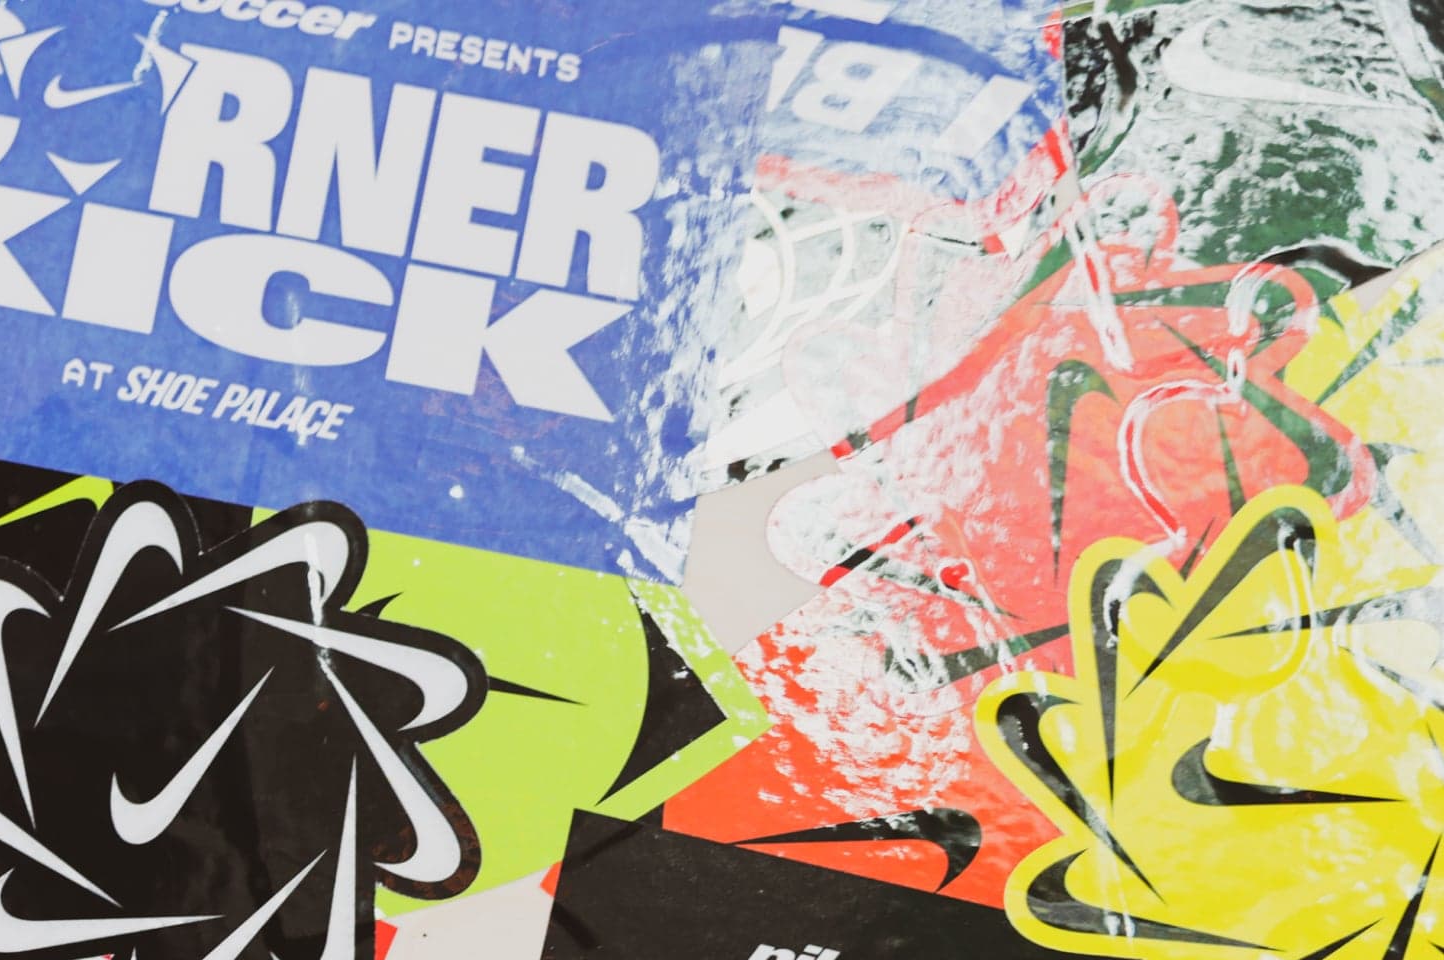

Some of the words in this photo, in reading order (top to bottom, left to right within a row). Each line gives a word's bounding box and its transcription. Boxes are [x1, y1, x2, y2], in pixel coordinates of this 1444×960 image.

[142, 0, 376, 40] ccer
[388, 21, 582, 82] PRESENTS
[61, 358, 113, 391] AT
[116, 365, 220, 416] SHOE
[211, 383, 355, 442] PALACE
